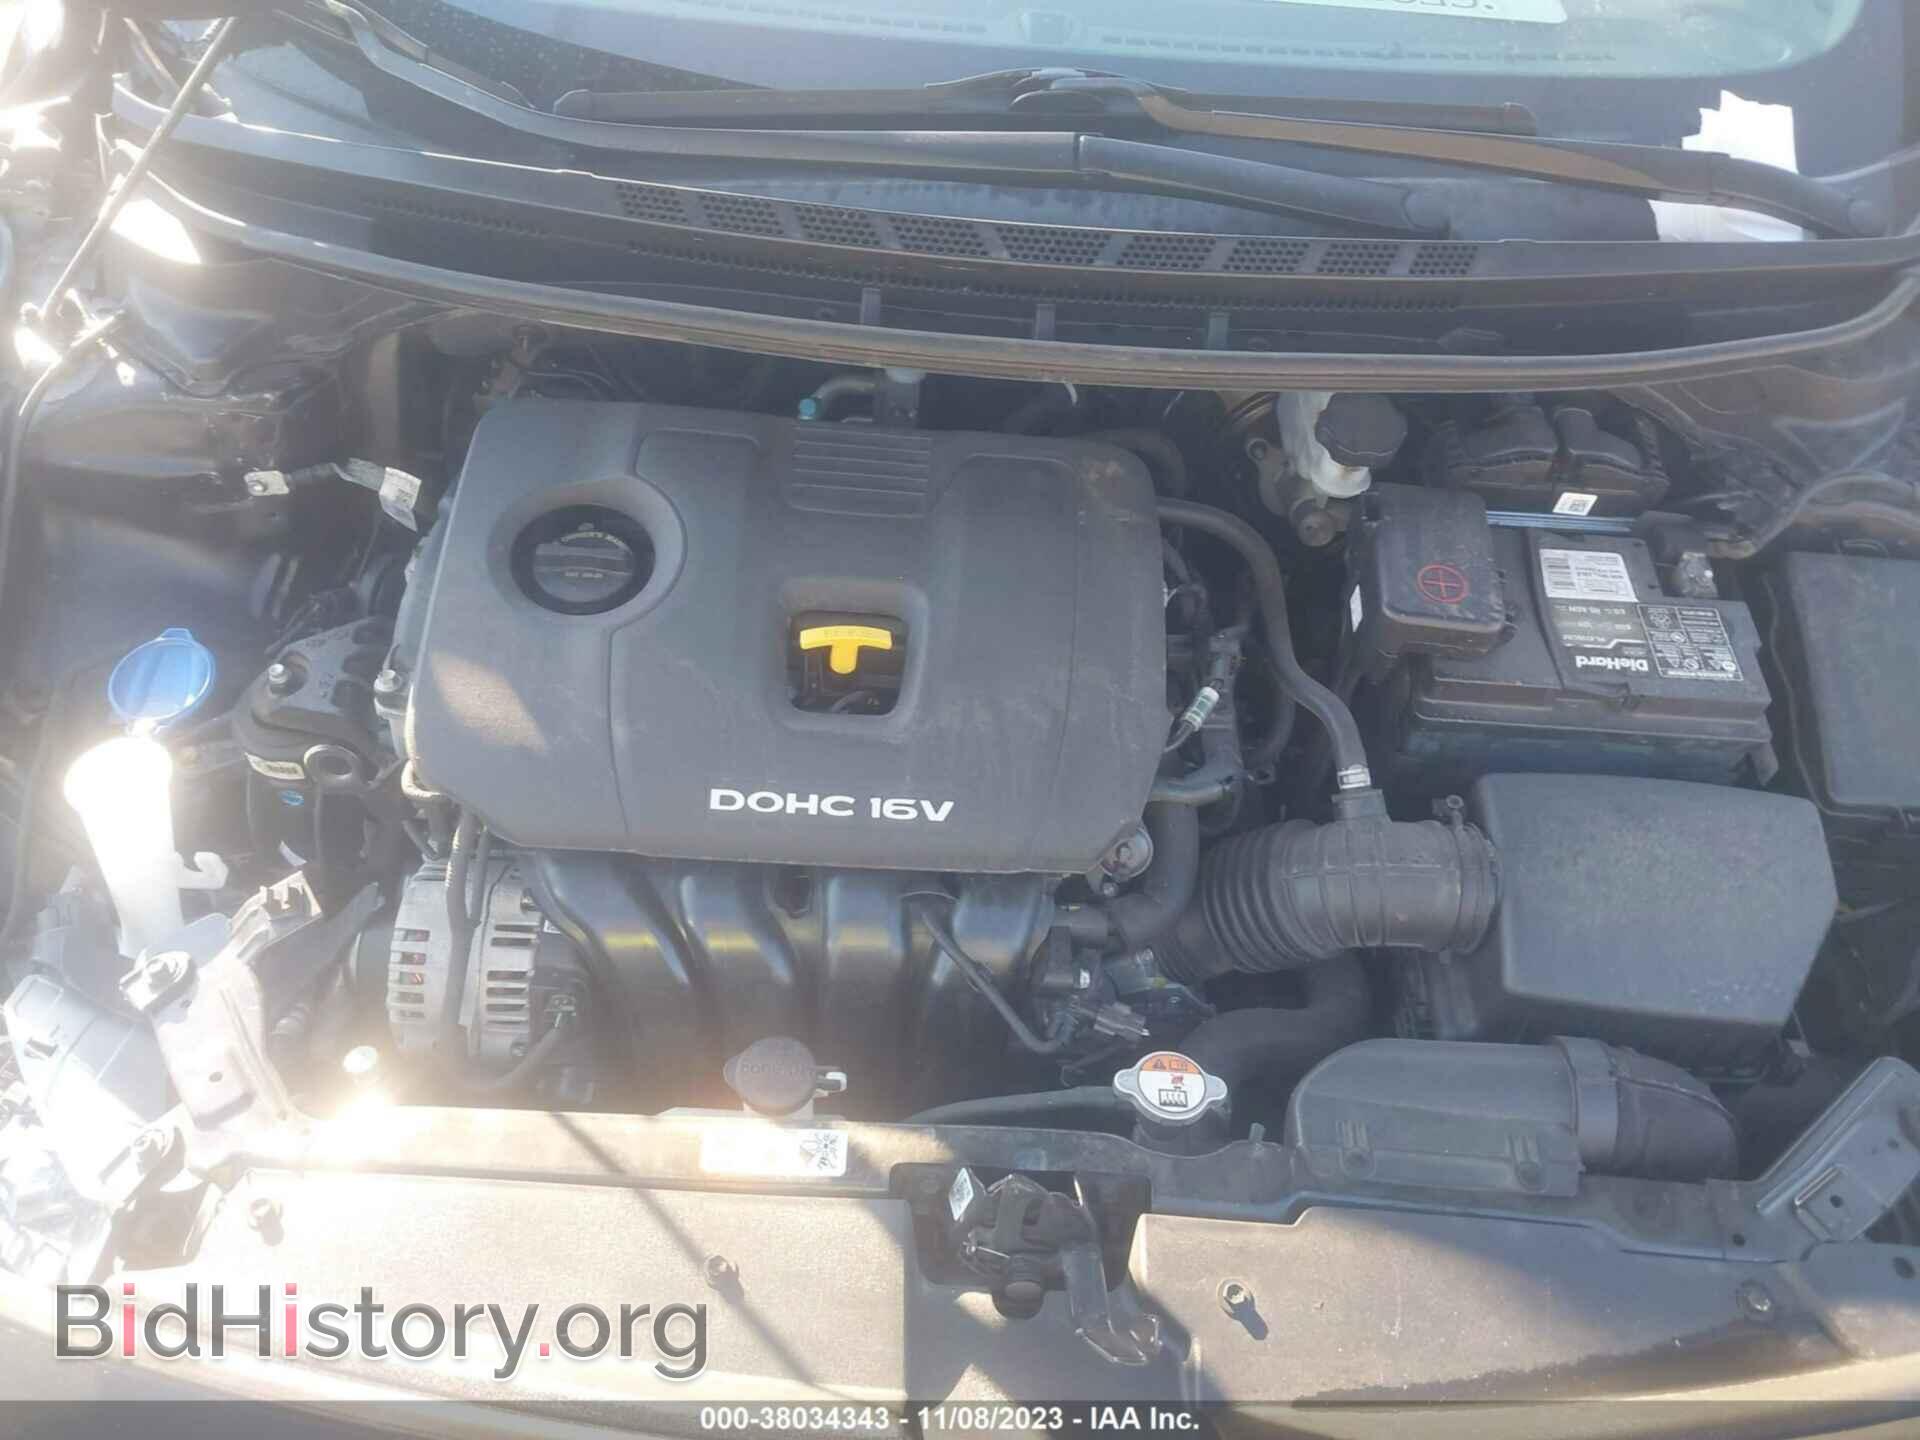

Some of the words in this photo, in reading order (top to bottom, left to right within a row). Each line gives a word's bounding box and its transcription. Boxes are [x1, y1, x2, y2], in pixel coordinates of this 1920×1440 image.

[1575, 655, 1649, 672] DieHard
[709, 788, 855, 817] DOHC
[870, 797, 954, 822] 16V
